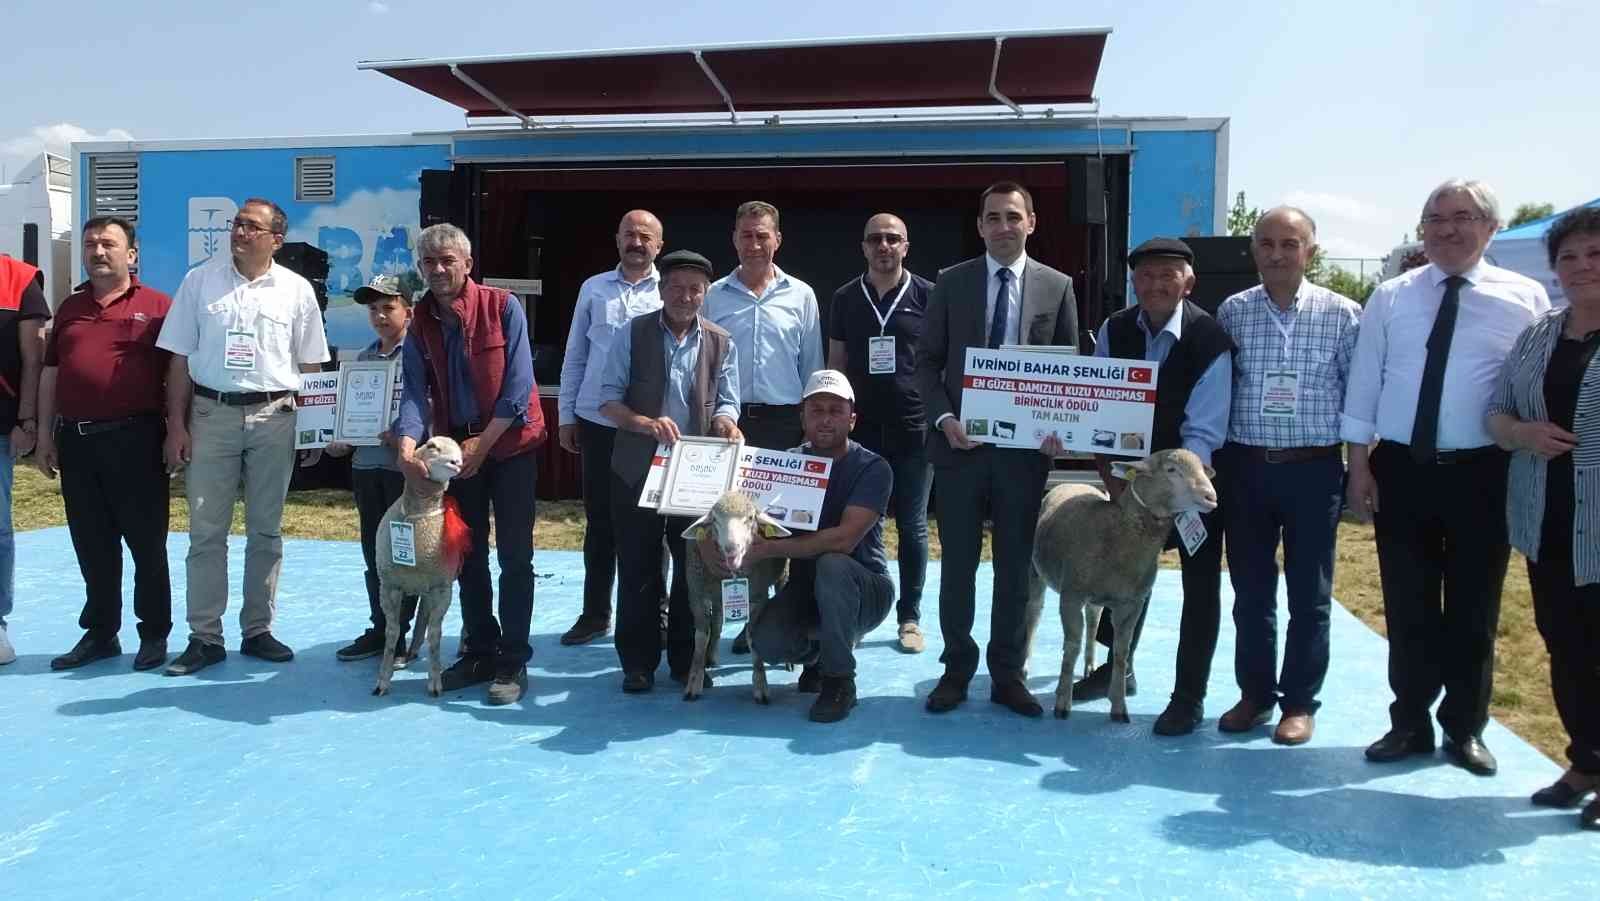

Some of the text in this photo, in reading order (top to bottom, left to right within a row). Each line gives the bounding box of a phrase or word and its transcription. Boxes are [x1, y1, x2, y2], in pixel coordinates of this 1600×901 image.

[972, 356, 1125, 380] İVRİNDİ BAHAR ŞENLİĞİ
[972, 378, 1146, 402] EN GÜZEL DAMIZLIK KUZU YARIŞMASI
[1014, 395, 1099, 412] BİRİNCİLİK ÖDÜLÜ
[1031, 410, 1080, 423] TAM ALTIN
[755, 455, 802, 470] ŞENLİĞİ
[742, 479, 772, 491] ÖDÜLÜ
